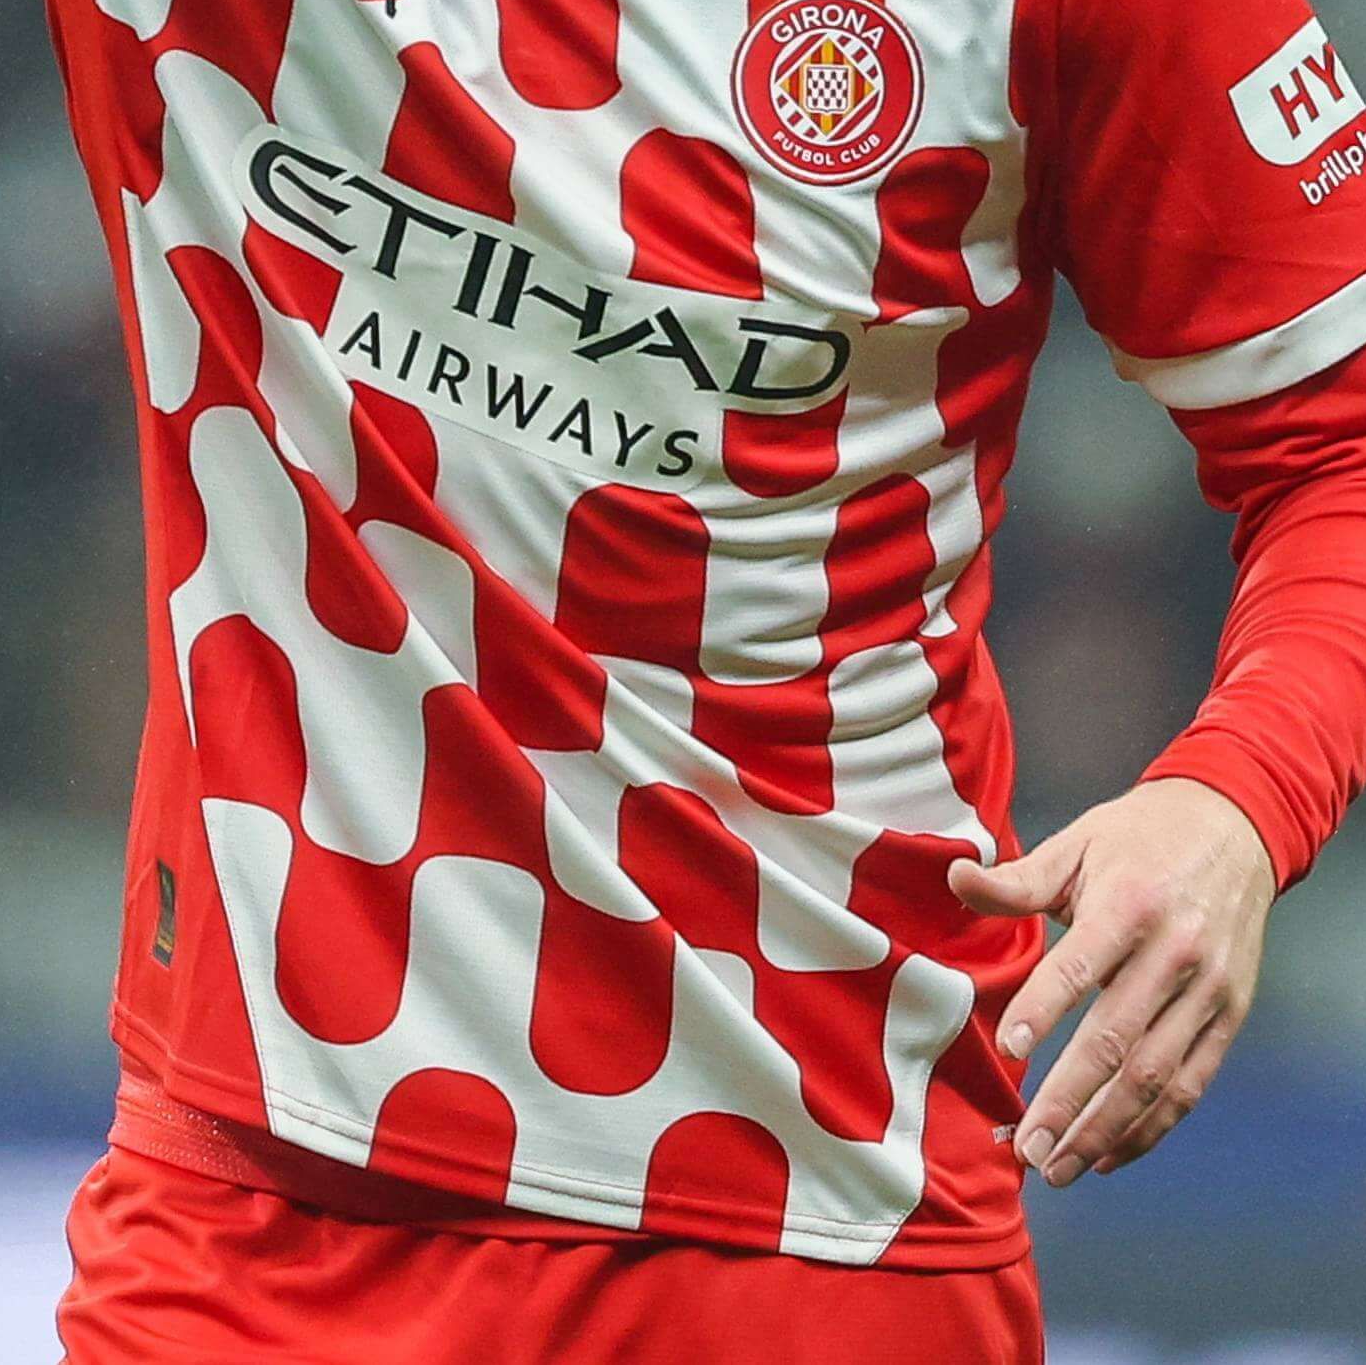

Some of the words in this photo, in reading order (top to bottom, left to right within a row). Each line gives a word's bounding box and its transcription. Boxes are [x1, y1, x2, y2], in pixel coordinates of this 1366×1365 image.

[771, 4, 884, 50] GIRONA
[1269, 42, 1345, 140] HY
[773, 130, 835, 166] FUTBOL
[840, 133, 881, 164] CLUB
[248, 139, 851, 401] ETIHAD
[339, 311, 699, 477] AIRWAYS
